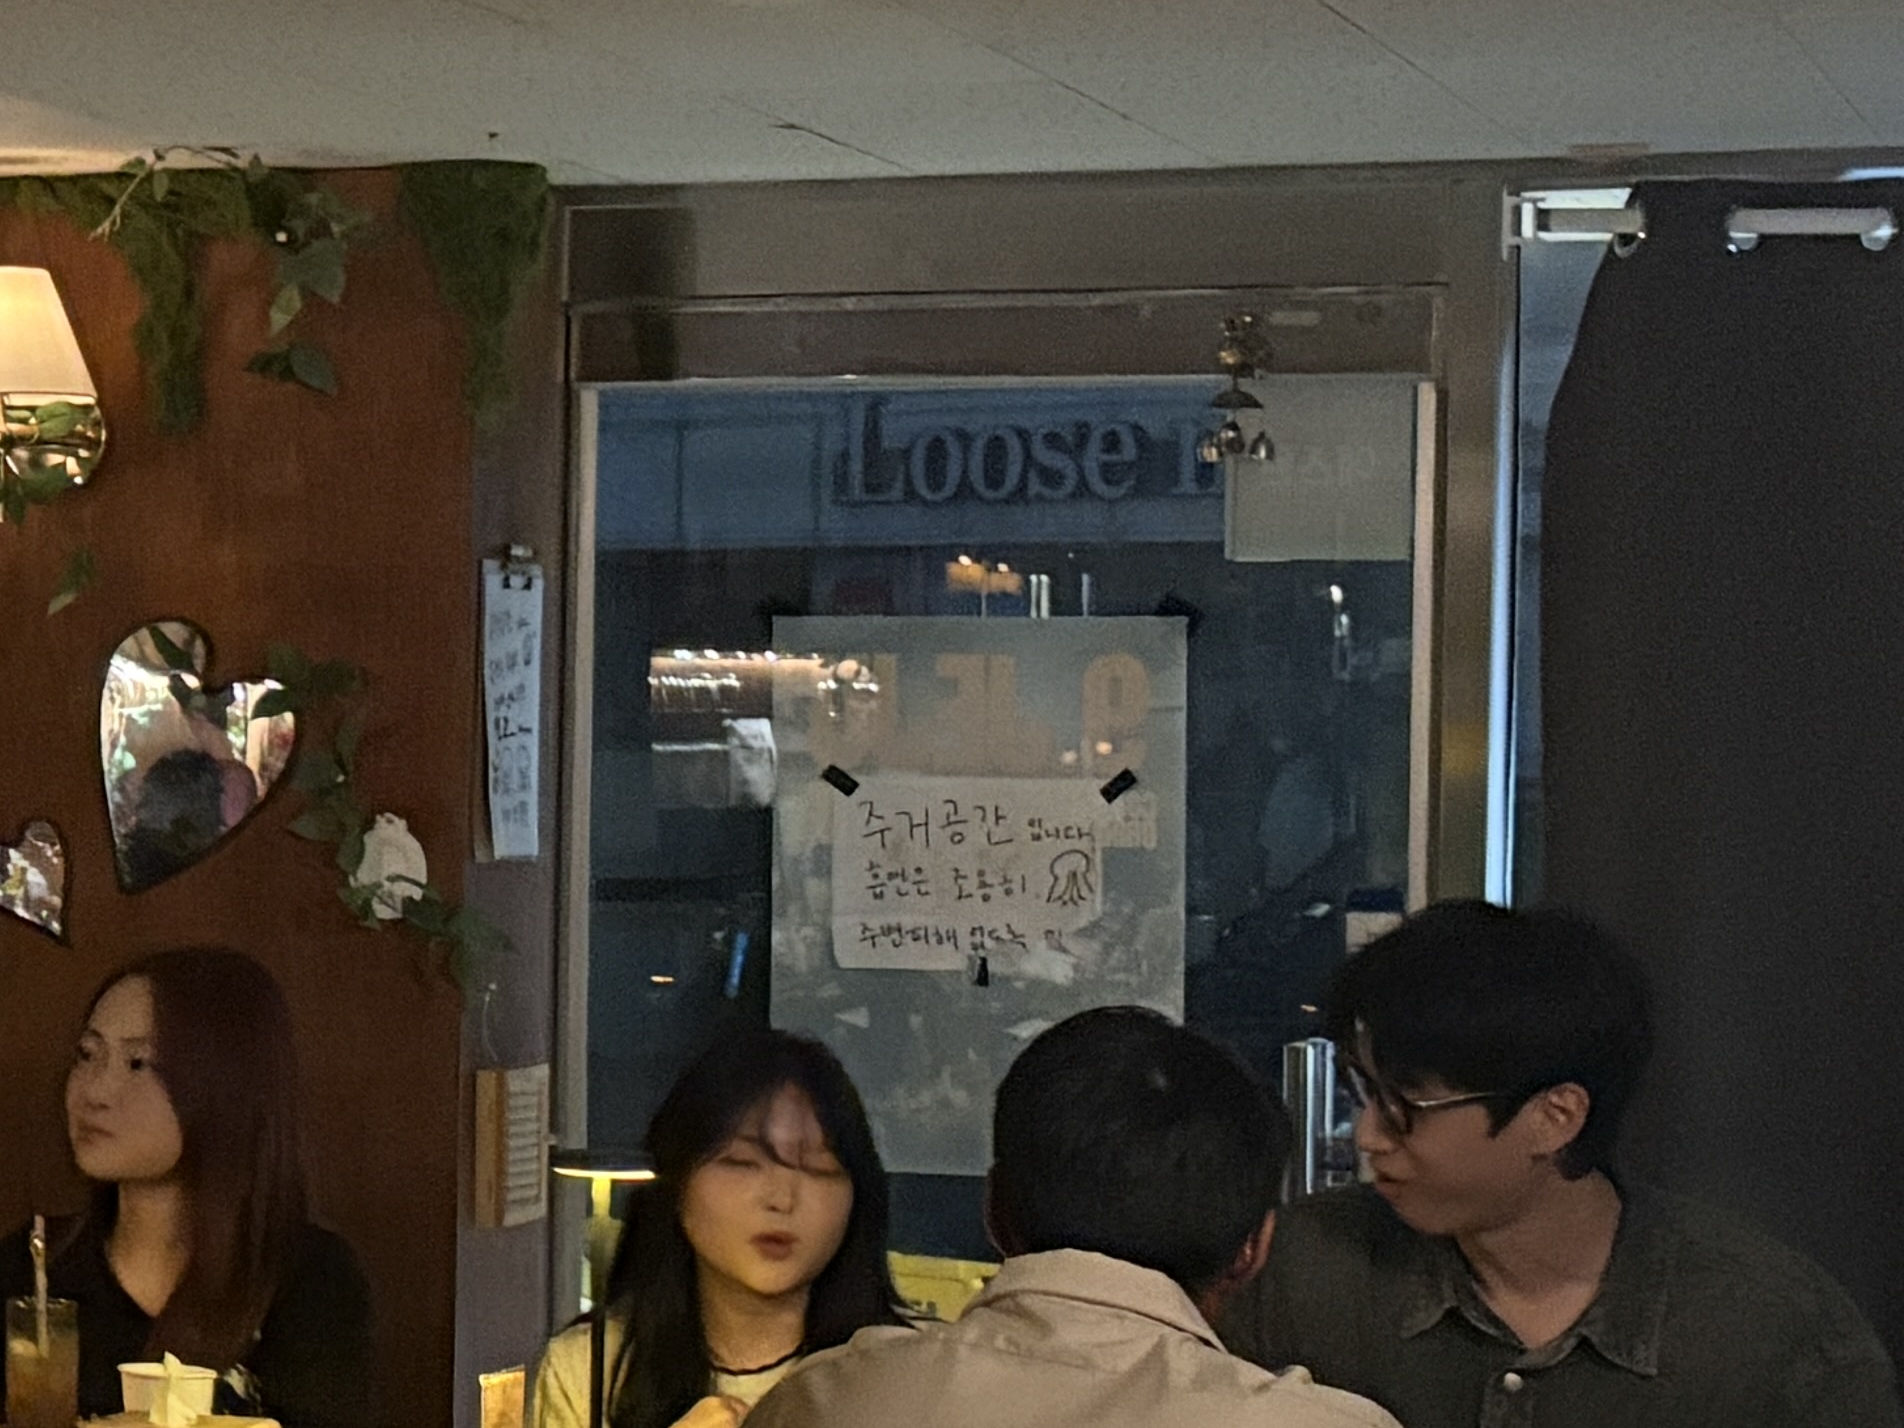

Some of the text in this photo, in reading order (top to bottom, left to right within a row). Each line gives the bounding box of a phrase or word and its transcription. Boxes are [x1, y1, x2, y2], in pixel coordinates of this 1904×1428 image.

[832, 396, 1138, 502] Loose
[858, 799, 1092, 849] 주거공간 입니다
[952, 867, 1027, 903] 조용히
